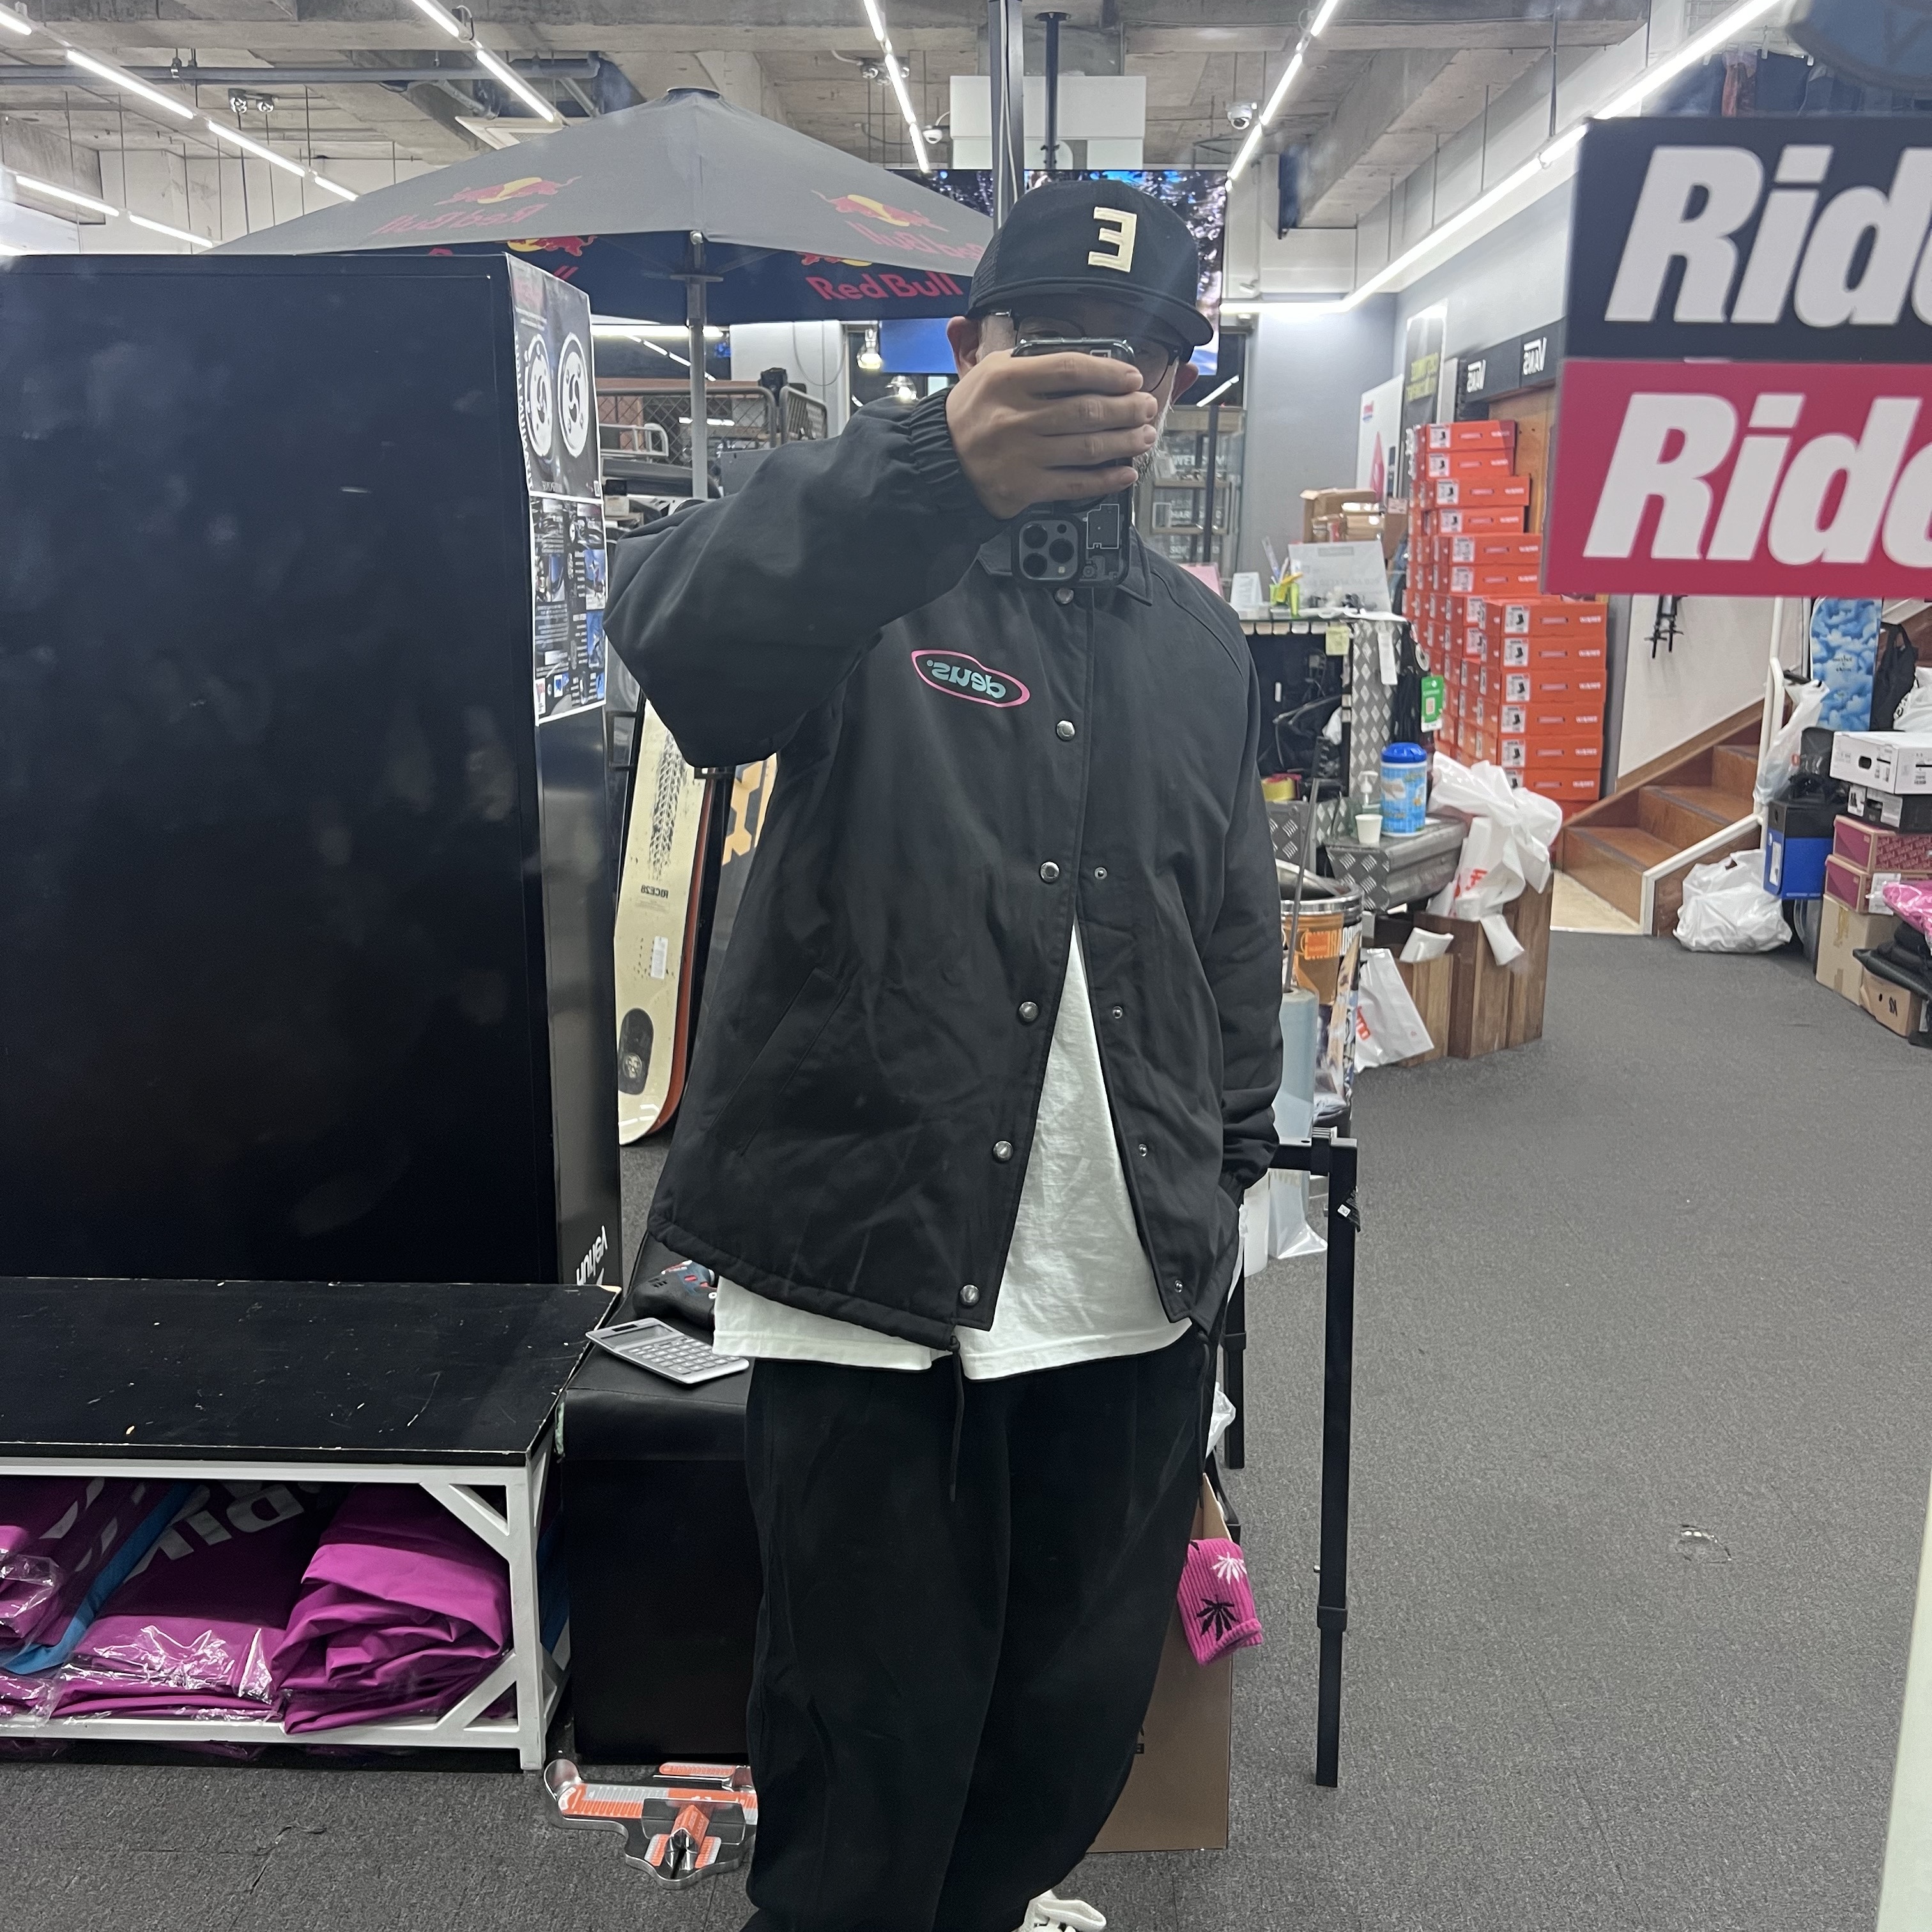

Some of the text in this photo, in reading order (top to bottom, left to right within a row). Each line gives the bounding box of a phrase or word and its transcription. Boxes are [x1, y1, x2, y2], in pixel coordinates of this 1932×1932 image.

[805, 269, 963, 300] Red Bull
[1604, 144, 1932, 327] Rid
